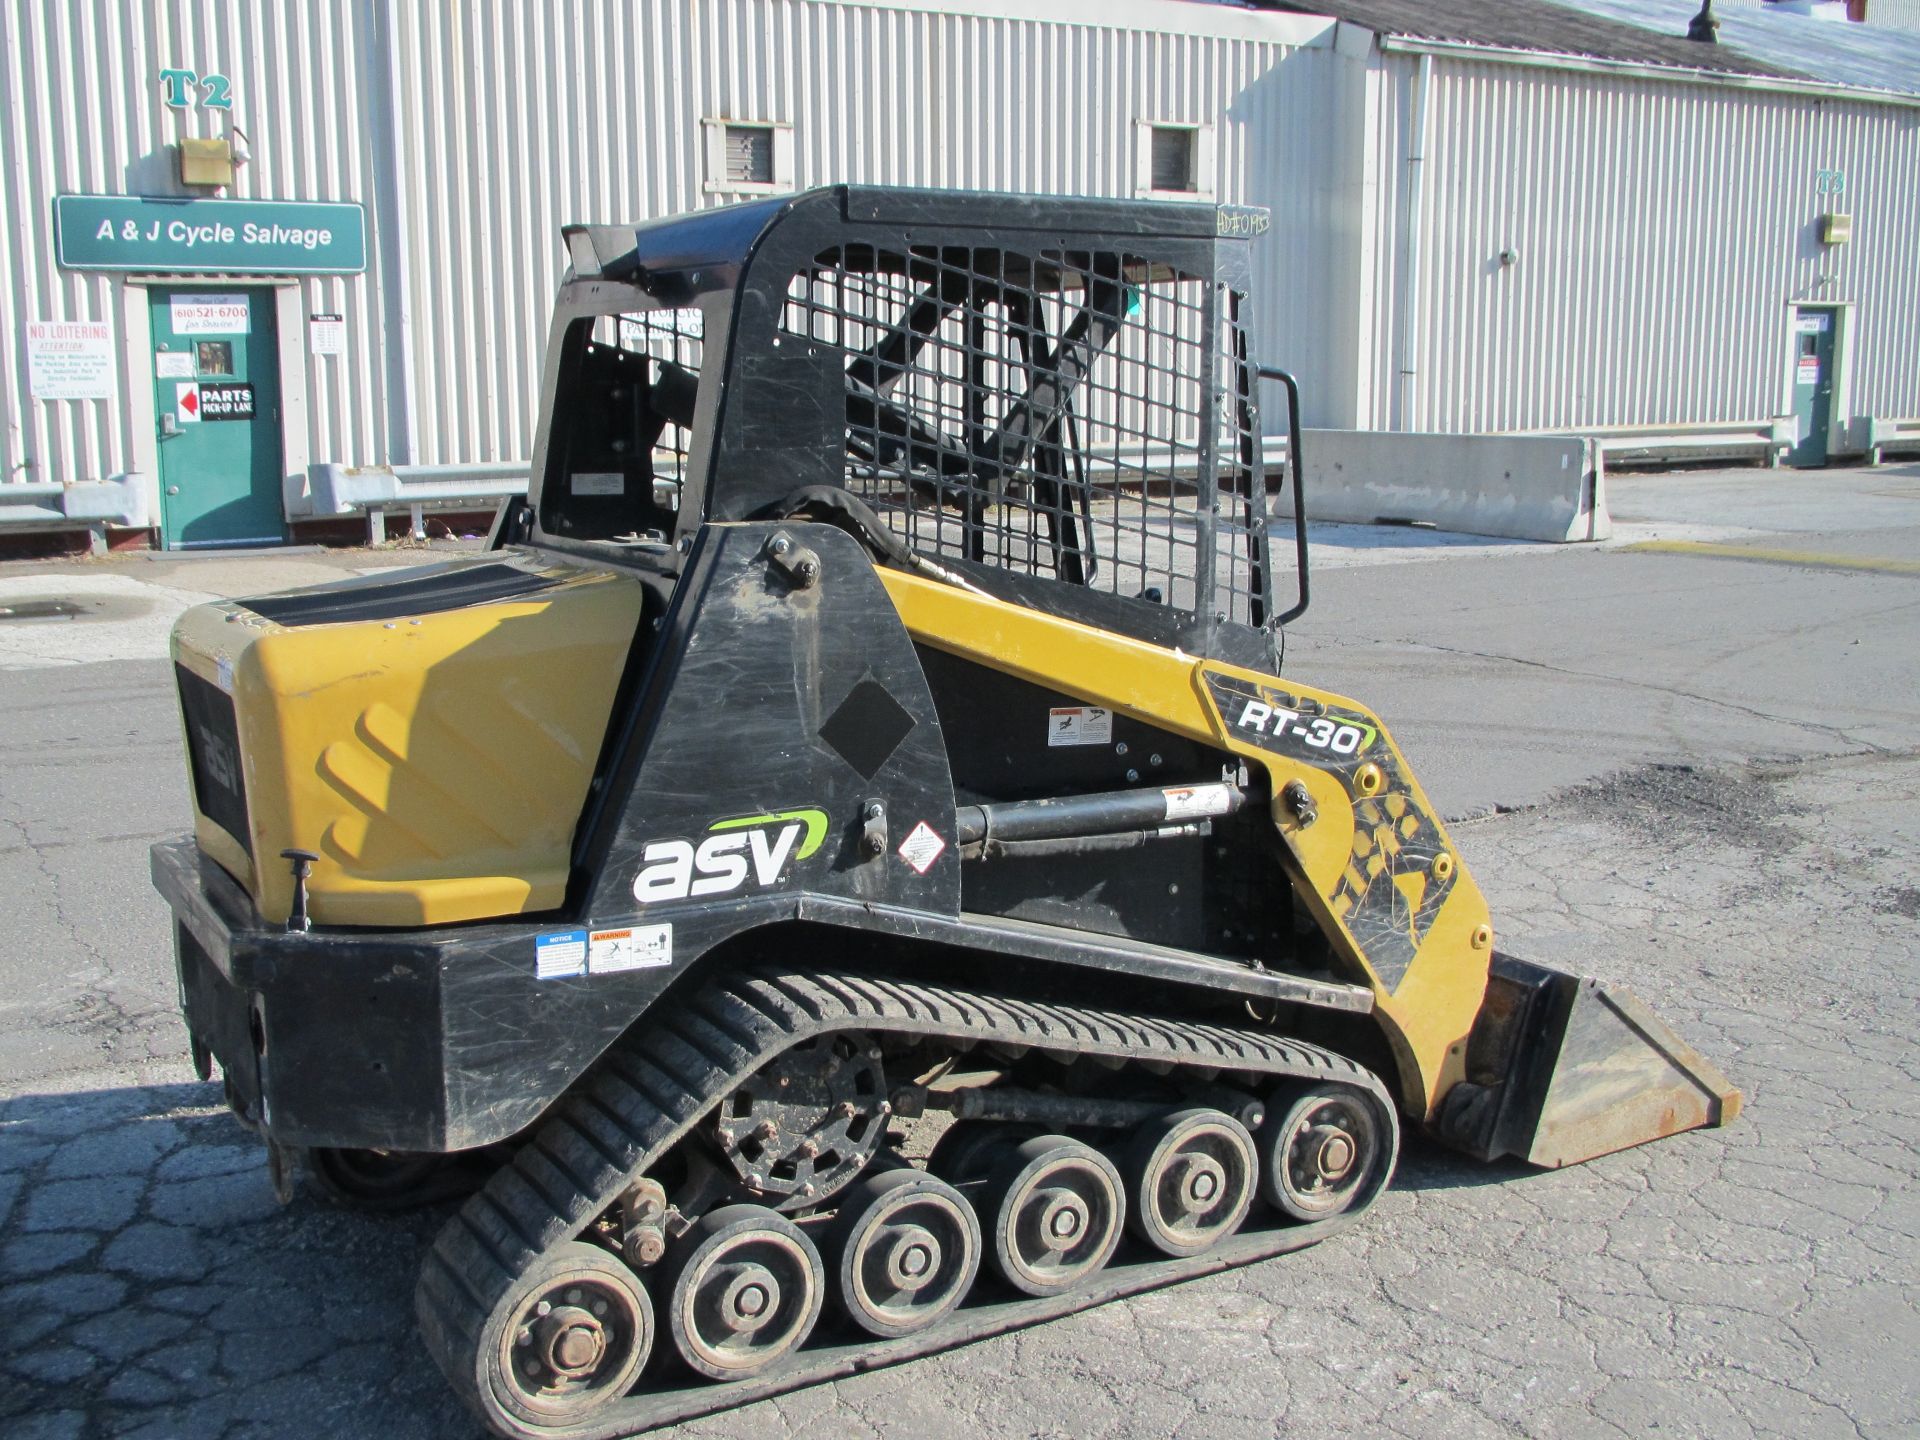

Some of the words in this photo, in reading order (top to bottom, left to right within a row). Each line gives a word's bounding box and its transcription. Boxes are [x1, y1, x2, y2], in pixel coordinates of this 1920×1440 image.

[1816, 169, 1844, 194] T3
[96, 220, 114, 241] A
[121, 221, 139, 241] &
[146, 221, 160, 241] J
[168, 222, 235, 247] Cycle
[243, 224, 332, 250] Salvage
[30, 325, 45, 339] NO
[51, 325, 108, 339] LOITERING
[201, 390, 252, 402] PARTS
[202, 402, 232, 413] PICK-UP
[234, 402, 253, 412] LANE
[1237, 700, 1361, 754] RT-30
[549, 935, 573, 943] NOTICE
[599, 931, 630, 940] WARNING
